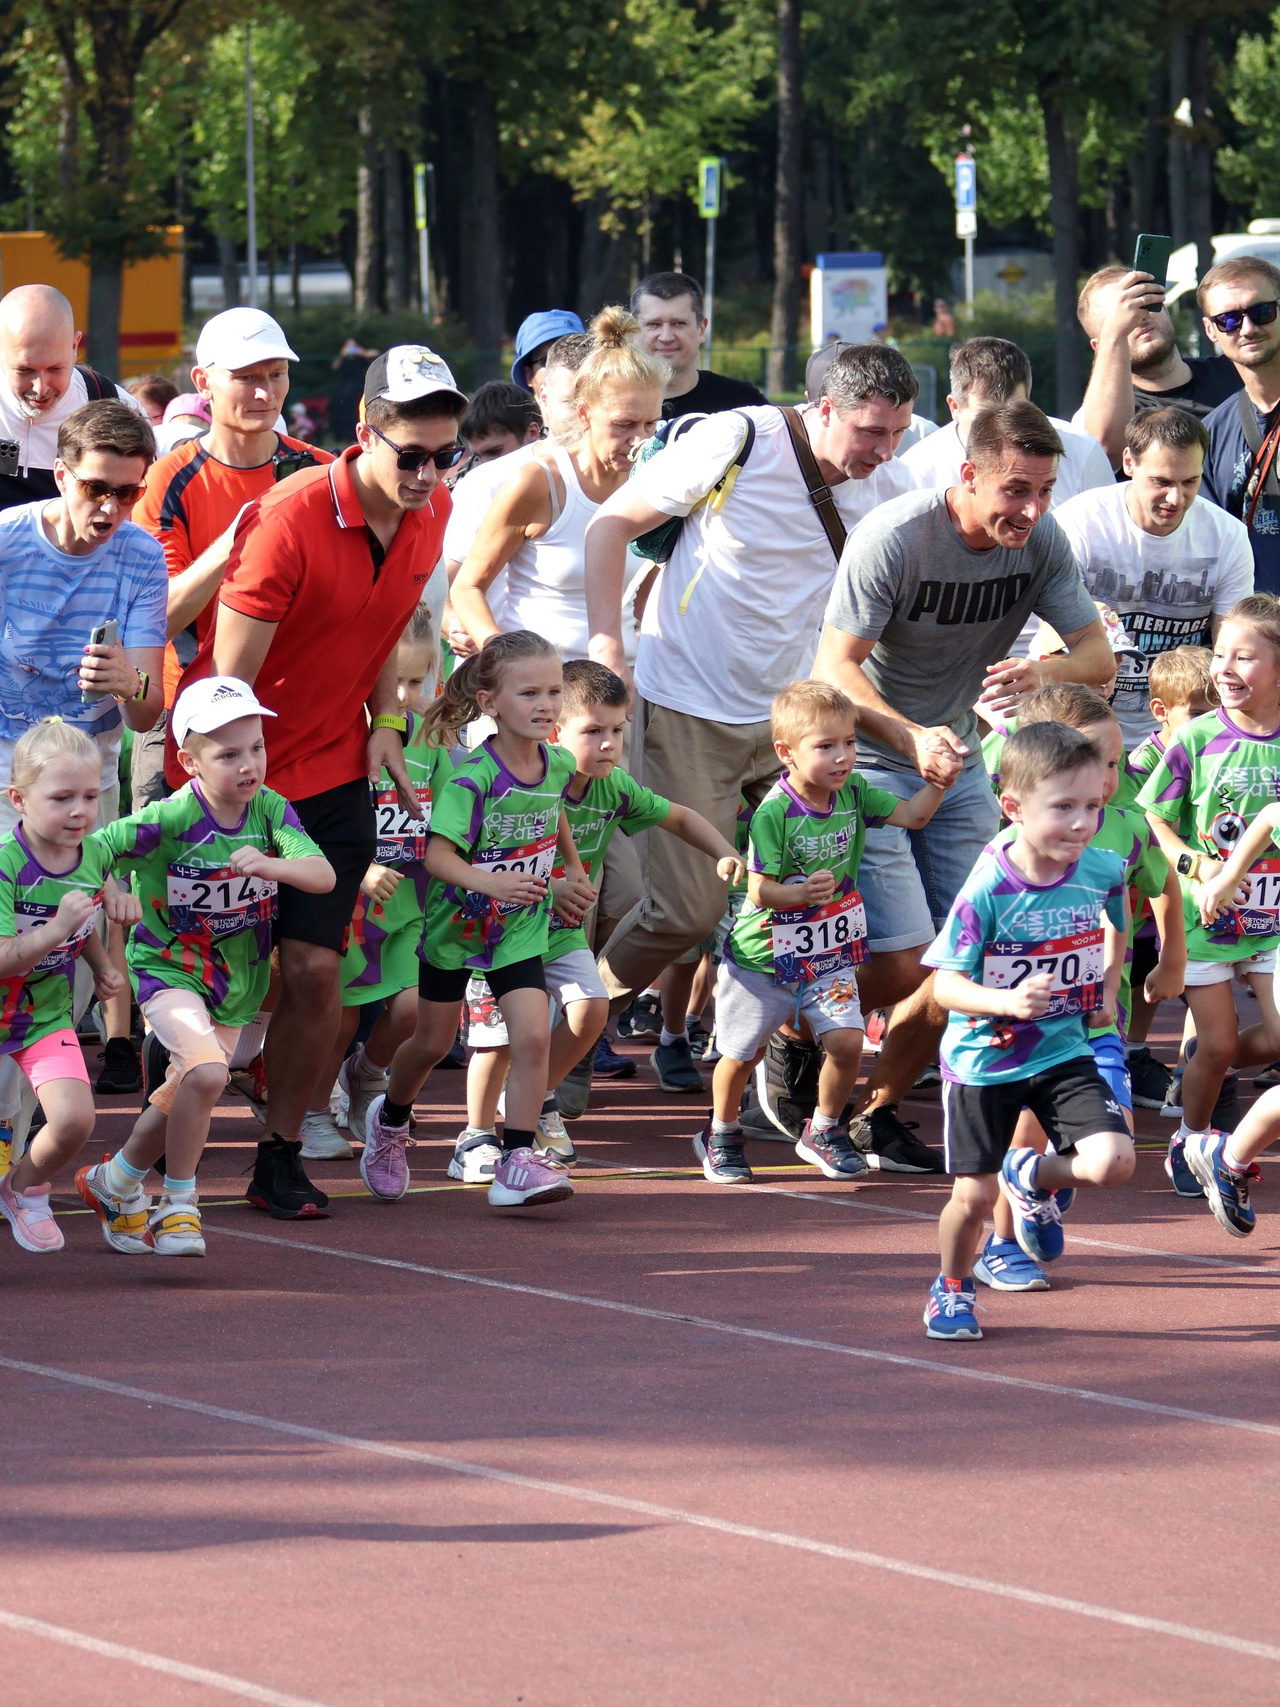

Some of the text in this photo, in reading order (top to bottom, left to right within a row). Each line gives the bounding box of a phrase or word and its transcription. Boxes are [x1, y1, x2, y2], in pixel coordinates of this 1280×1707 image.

[907, 572, 1032, 625] PUMA
[1132, 614, 1209, 635] HERITAGE
[1138, 631, 1202, 652] UNITED
[1115, 682, 1134, 691] USTLE
[211, 691, 243, 704] adidas
[379, 806, 413, 835] 22
[481, 850, 502, 861] 4-5
[176, 866, 200, 878] 4-5
[191, 877, 257, 910] 214
[23, 903, 47, 914] 4-5
[780, 912, 803, 923] 4-5
[794, 915, 850, 954] 318
[995, 943, 1023, 954] 4-5
[1010, 953, 1080, 989] 270
